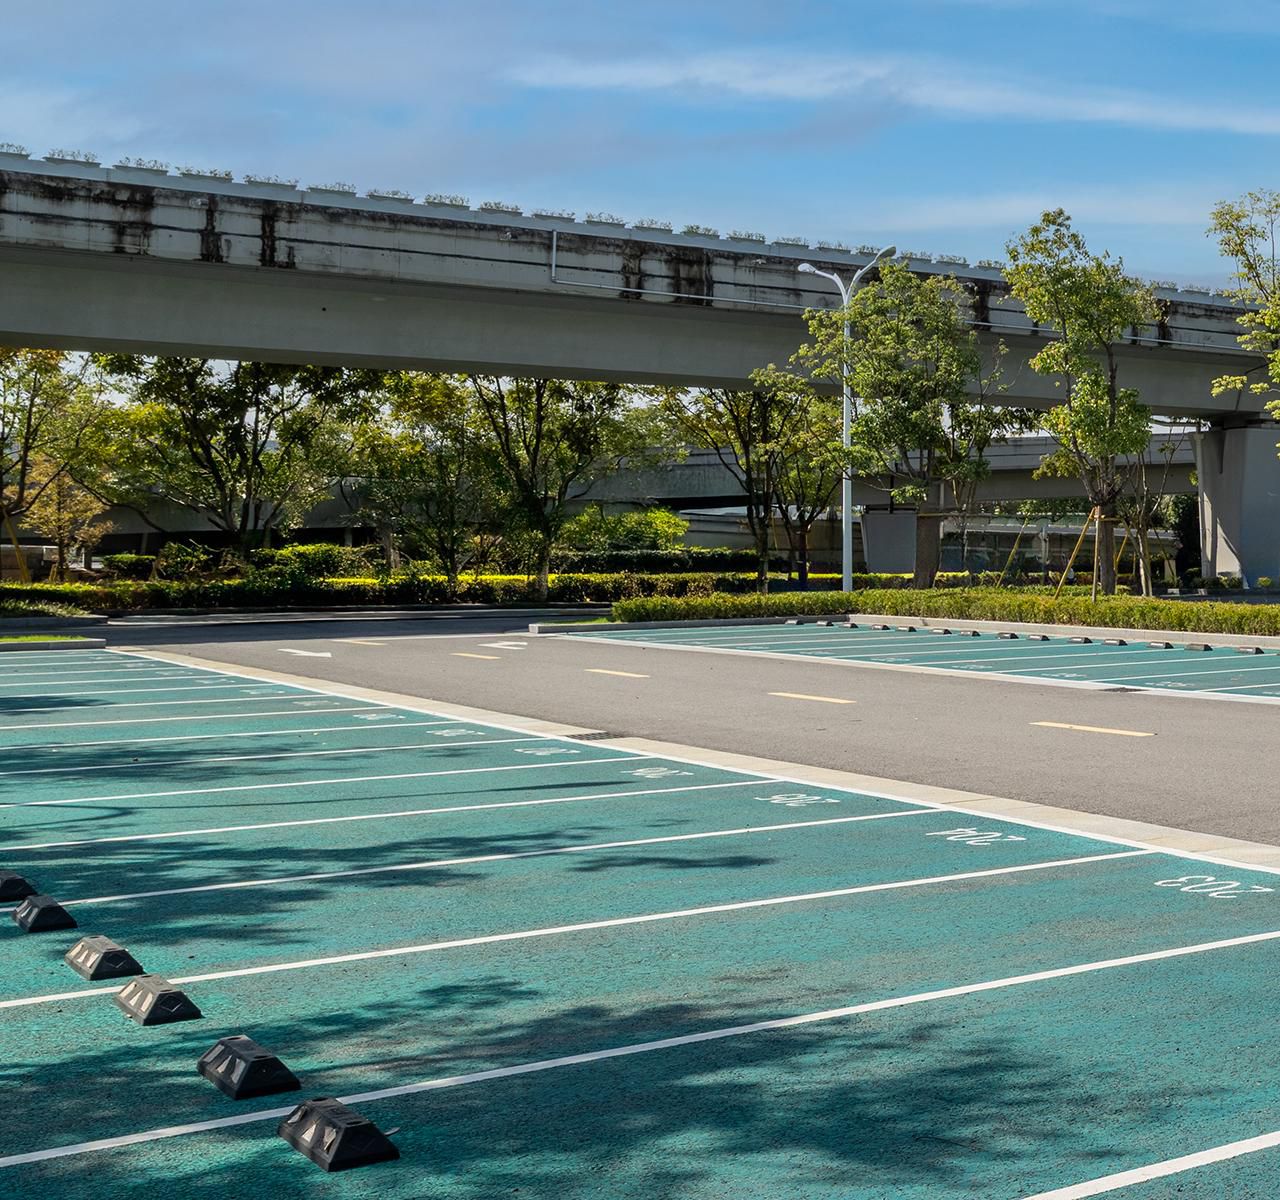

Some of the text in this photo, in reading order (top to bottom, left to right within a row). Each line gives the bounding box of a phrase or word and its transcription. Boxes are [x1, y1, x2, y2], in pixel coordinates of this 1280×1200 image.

[753, 793, 841, 807] 205
[925, 827, 1027, 846] 204
[1153, 875, 1276, 899] 203
